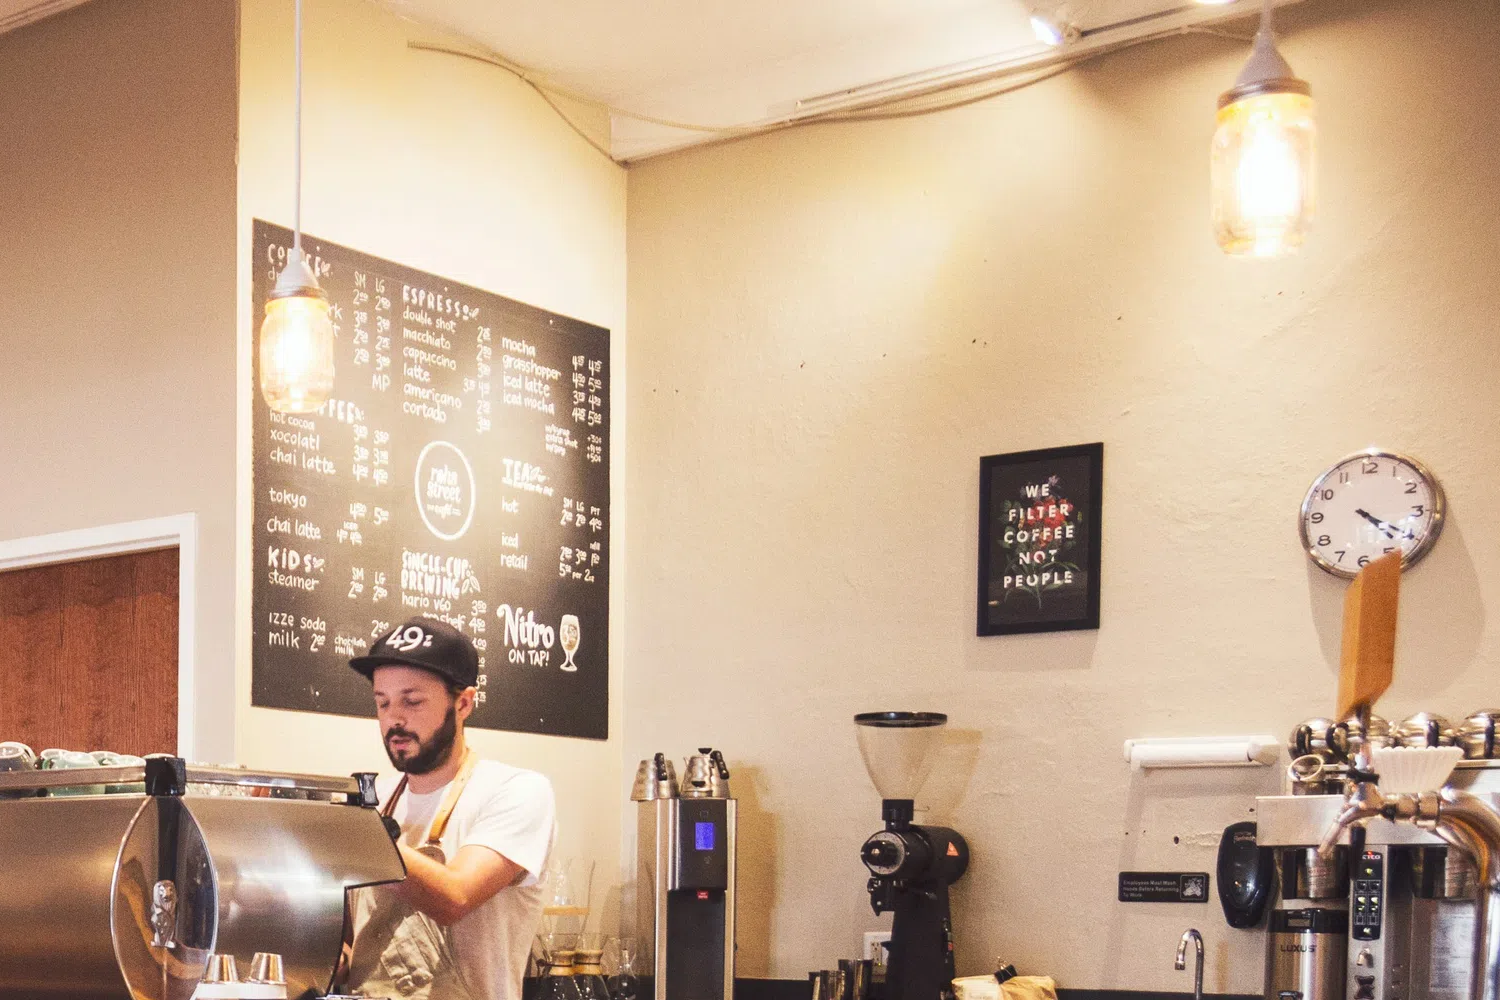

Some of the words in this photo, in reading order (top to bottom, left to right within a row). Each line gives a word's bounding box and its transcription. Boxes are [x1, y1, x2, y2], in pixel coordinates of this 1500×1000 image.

[403, 284, 469, 320] ESPRESSO
[403, 305, 432, 326] double
[435, 317, 456, 331] shot
[403, 327, 451, 350] macchiato
[502, 337, 536, 357] mocha
[402, 346, 457, 370] cappuccino
[502, 354, 562, 380] grasshopper
[403, 362, 431, 383] latte
[503, 371, 522, 389] iced
[525, 377, 551, 397] latte
[403, 383, 463, 409] americano
[503, 389, 522, 406] iced
[524, 397, 556, 416] mocha
[269, 409, 285, 424] hot
[287, 416, 315, 431] cocoa
[402, 401, 448, 423] cortado
[269, 429, 320, 450] xocolatl
[269, 446, 297, 466] chai
[302, 452, 336, 475] latte
[1361, 462, 1378, 474] 12
[1026, 483, 1050, 498] WE
[1320, 488, 1334, 501] 10
[1404, 482, 1417, 494] 2
[269, 487, 307, 509] tokyo
[502, 495, 519, 514] hot
[1008, 502, 1070, 522] FILTER
[1310, 512, 1324, 524] 9
[1411, 505, 1424, 517] 3
[295, 519, 321, 539] latte
[1003, 525, 1075, 544] COFFEE
[502, 532, 519, 549] iced
[1317, 535, 1331, 547] 8
[501, 553, 528, 571] retail
[1019, 549, 1058, 565] NOT
[1334, 550, 1346, 563] 7
[268, 569, 320, 591] steamer
[352, 567, 364, 580] SM
[1003, 571, 1073, 588] PEOPLE
[401, 591, 430, 608] hario
[300, 616, 326, 632] soda
[496, 603, 555, 649] Nitro
[269, 629, 300, 650] milk
[335, 645, 355, 656] milk
[508, 648, 525, 664] ON
[527, 649, 550, 667] TAP!
[1280, 944, 1317, 953] LUXUS
